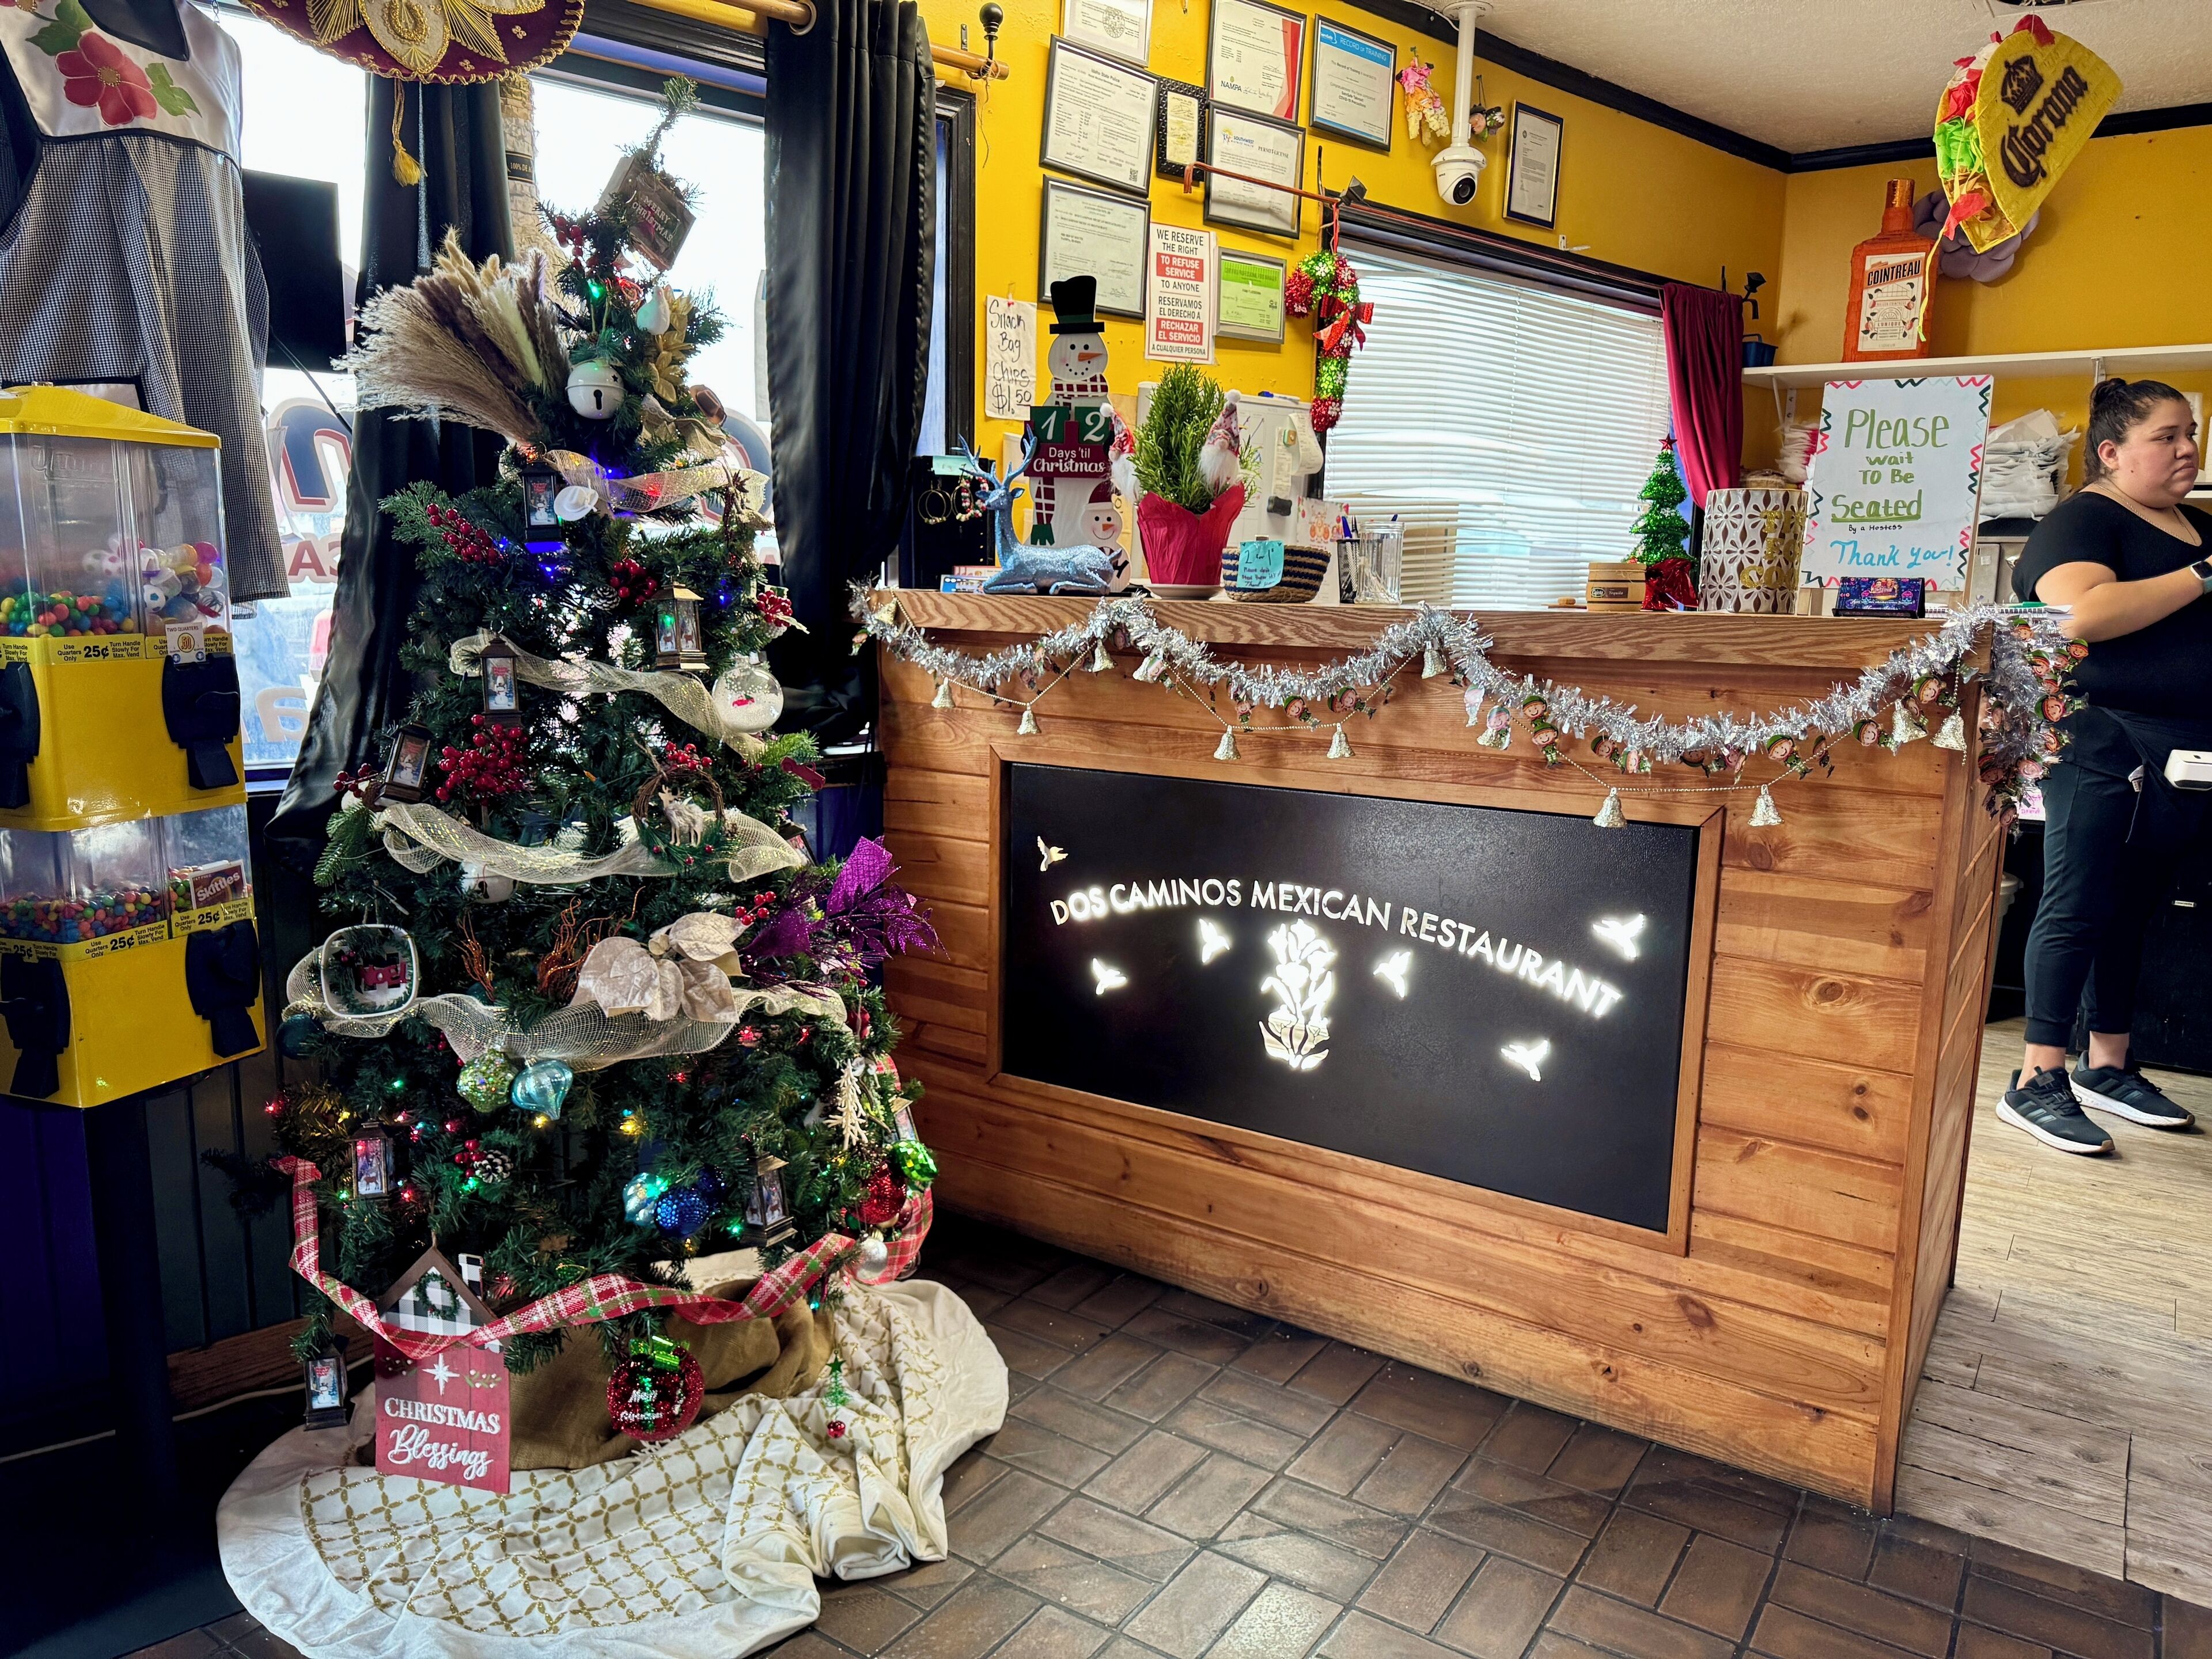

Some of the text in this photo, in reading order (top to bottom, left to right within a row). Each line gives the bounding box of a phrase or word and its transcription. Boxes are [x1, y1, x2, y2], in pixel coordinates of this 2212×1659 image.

[1340, 37, 1359, 50] RECORD
[1366, 47, 1387, 61] TRAINING
[1221, 80, 1242, 92] NAMPA
[1999, 65, 2088, 188] Corona
[1233, 135, 1254, 145] SOUTHWEST
[510, 162, 522, 171] 100%
[522, 164, 528, 172] DE
[643, 195, 671, 224] MERRY
[632, 202, 673, 242] CHRISTMAS
[1157, 228, 1204, 246] WE RESERVE
[1162, 242, 1198, 256] THE RIGHT
[1160, 255, 1200, 270] TO REFUSE
[1165, 266, 1195, 279] SERVICE
[1867, 260, 1921, 286] COINTREAU
[1161, 279, 1200, 293] TO ANYONE
[1158, 296, 1202, 310] RESERVAMOS
[989, 299, 1026, 331] Snack
[1159, 307, 1201, 320] EL DERECHO A
[1161, 320, 1199, 332] RECHAZAR
[1158, 330, 1200, 343] EL SERVICIO
[998, 331, 1021, 363] Bag
[1156, 344, 1184, 354] CUALQUIER
[1184, 346, 1206, 355] PERSONA
[993, 361, 1031, 388] Chips
[1844, 408, 1950, 449] Please
[1048, 447, 1090, 461] Days 'til
[1865, 452, 1914, 465] wait
[1033, 458, 1106, 473] Christmas
[1891, 468, 1915, 484] Be
[1831, 489, 1923, 520] Seated
[1849, 524, 1857, 535] By
[1244, 550, 1253, 564] 2
[1830, 540, 1900, 567] Thank
[180, 636, 192, 650] .50
[84, 645, 109, 659] 25¢
[196, 872, 240, 902] Skittles
[175, 919, 196, 927] Quarters
[198, 911, 220, 925] 25¢
[147, 924, 165, 932] Handle
[110, 934, 135, 951] 25¢
[137, 933, 154, 941] Slowly
[85, 945, 108, 954] Quarters
[1050, 877, 1622, 1019] DOS CAMINOS MEXICAN RESTAURANT
[384, 1397, 501, 1435] CHRISTMAS
[388, 1423, 494, 1481] Blessings
